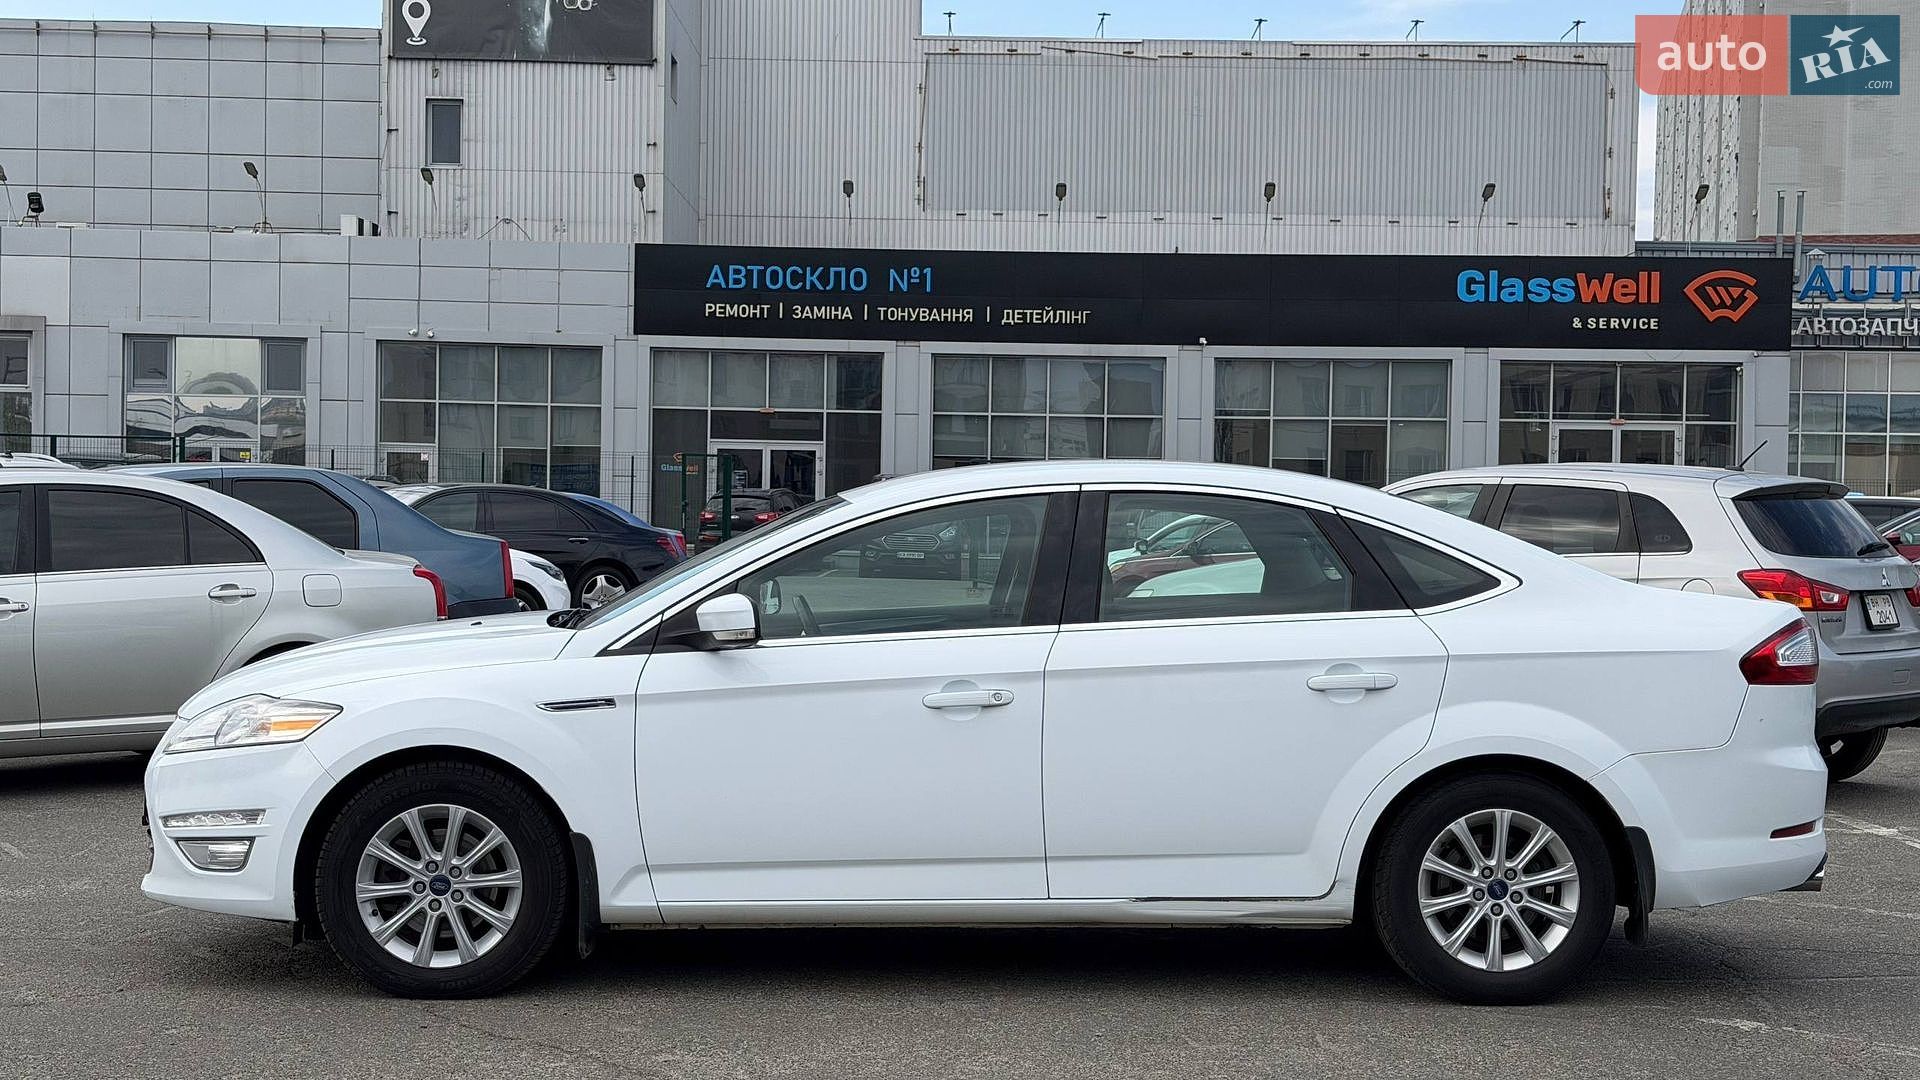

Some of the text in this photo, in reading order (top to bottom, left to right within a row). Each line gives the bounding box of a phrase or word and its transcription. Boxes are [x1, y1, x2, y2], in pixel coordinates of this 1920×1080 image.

[706, 264, 933, 293] АВТОСКЛО №1
[1456, 269, 1661, 304] GlassWell
[1798, 264, 1920, 302] AUT
[705, 303, 1091, 326] РЕМОНТ ЗАМІНА ТОНУВАННЯ ДЕТЕЙЛІНГ
[1572, 317, 1659, 330] & SERVICE
[1796, 317, 1920, 336] АВТОЗАПЧ
[1876, 610, 1895, 624] 2041
